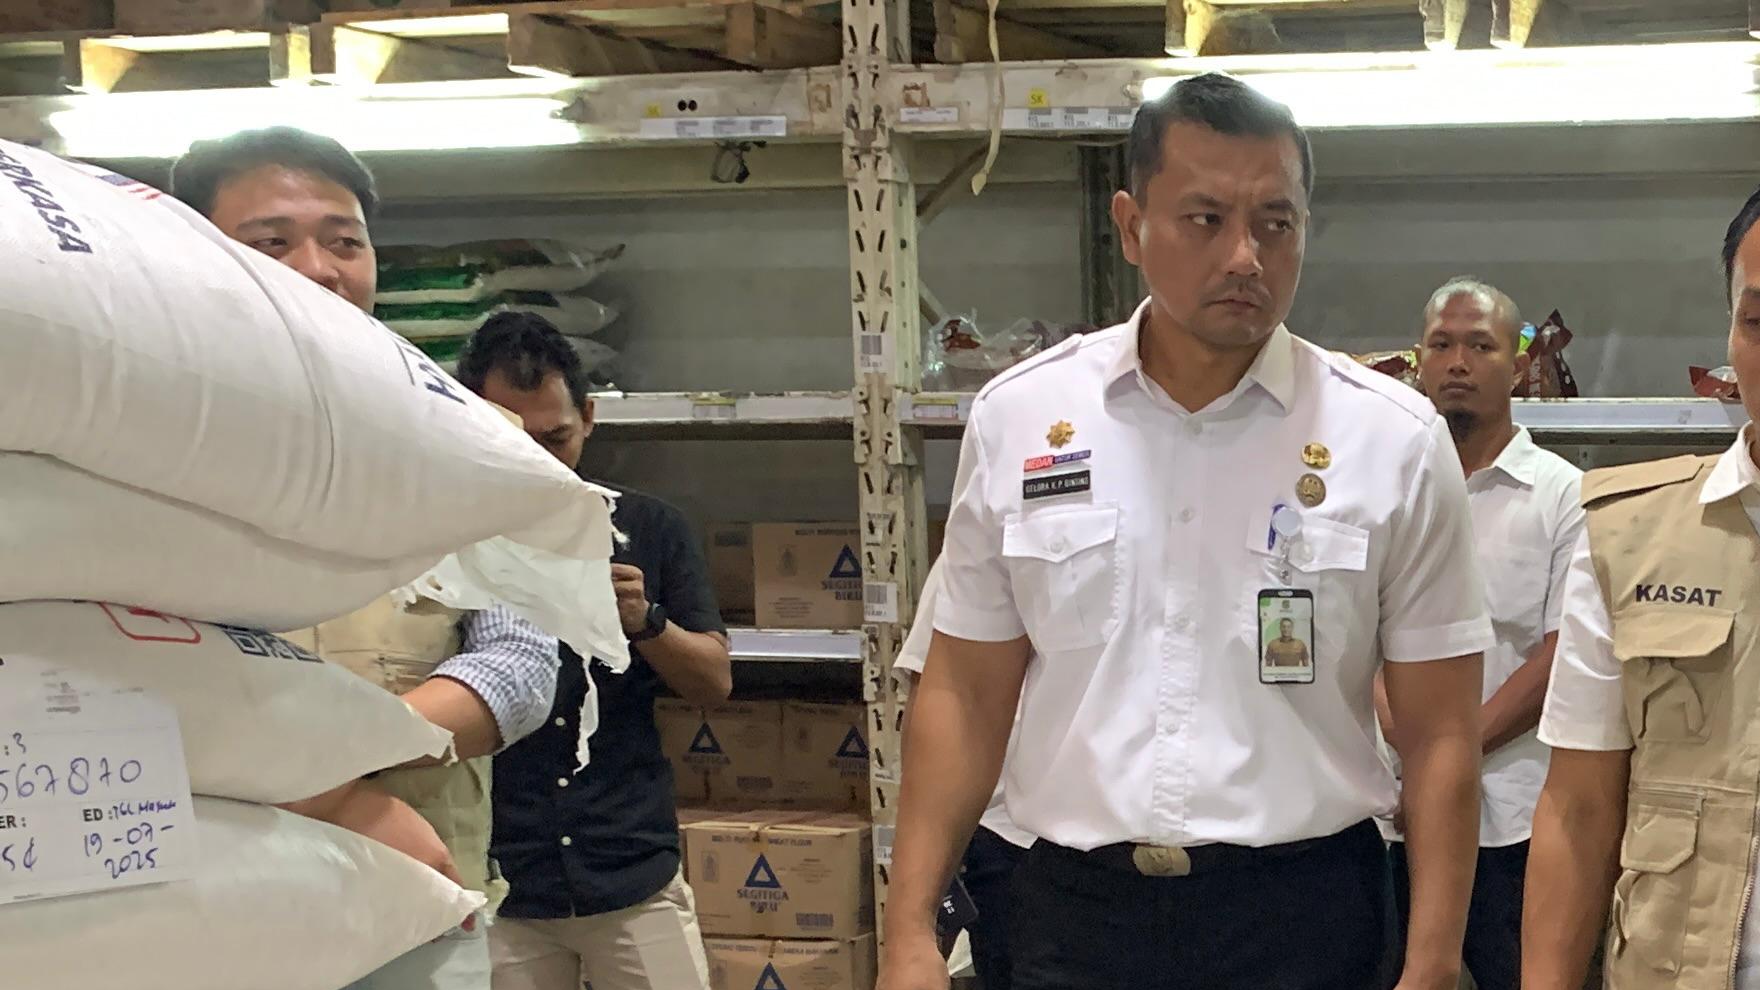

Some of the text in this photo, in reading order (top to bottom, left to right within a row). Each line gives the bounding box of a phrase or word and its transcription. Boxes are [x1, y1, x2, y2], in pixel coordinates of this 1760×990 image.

[1636, 584, 1722, 607] KASAT
[83, 808, 104, 822] ED
[104, 847, 159, 879] 2025
[737, 889, 789, 901] SEGITIGA
